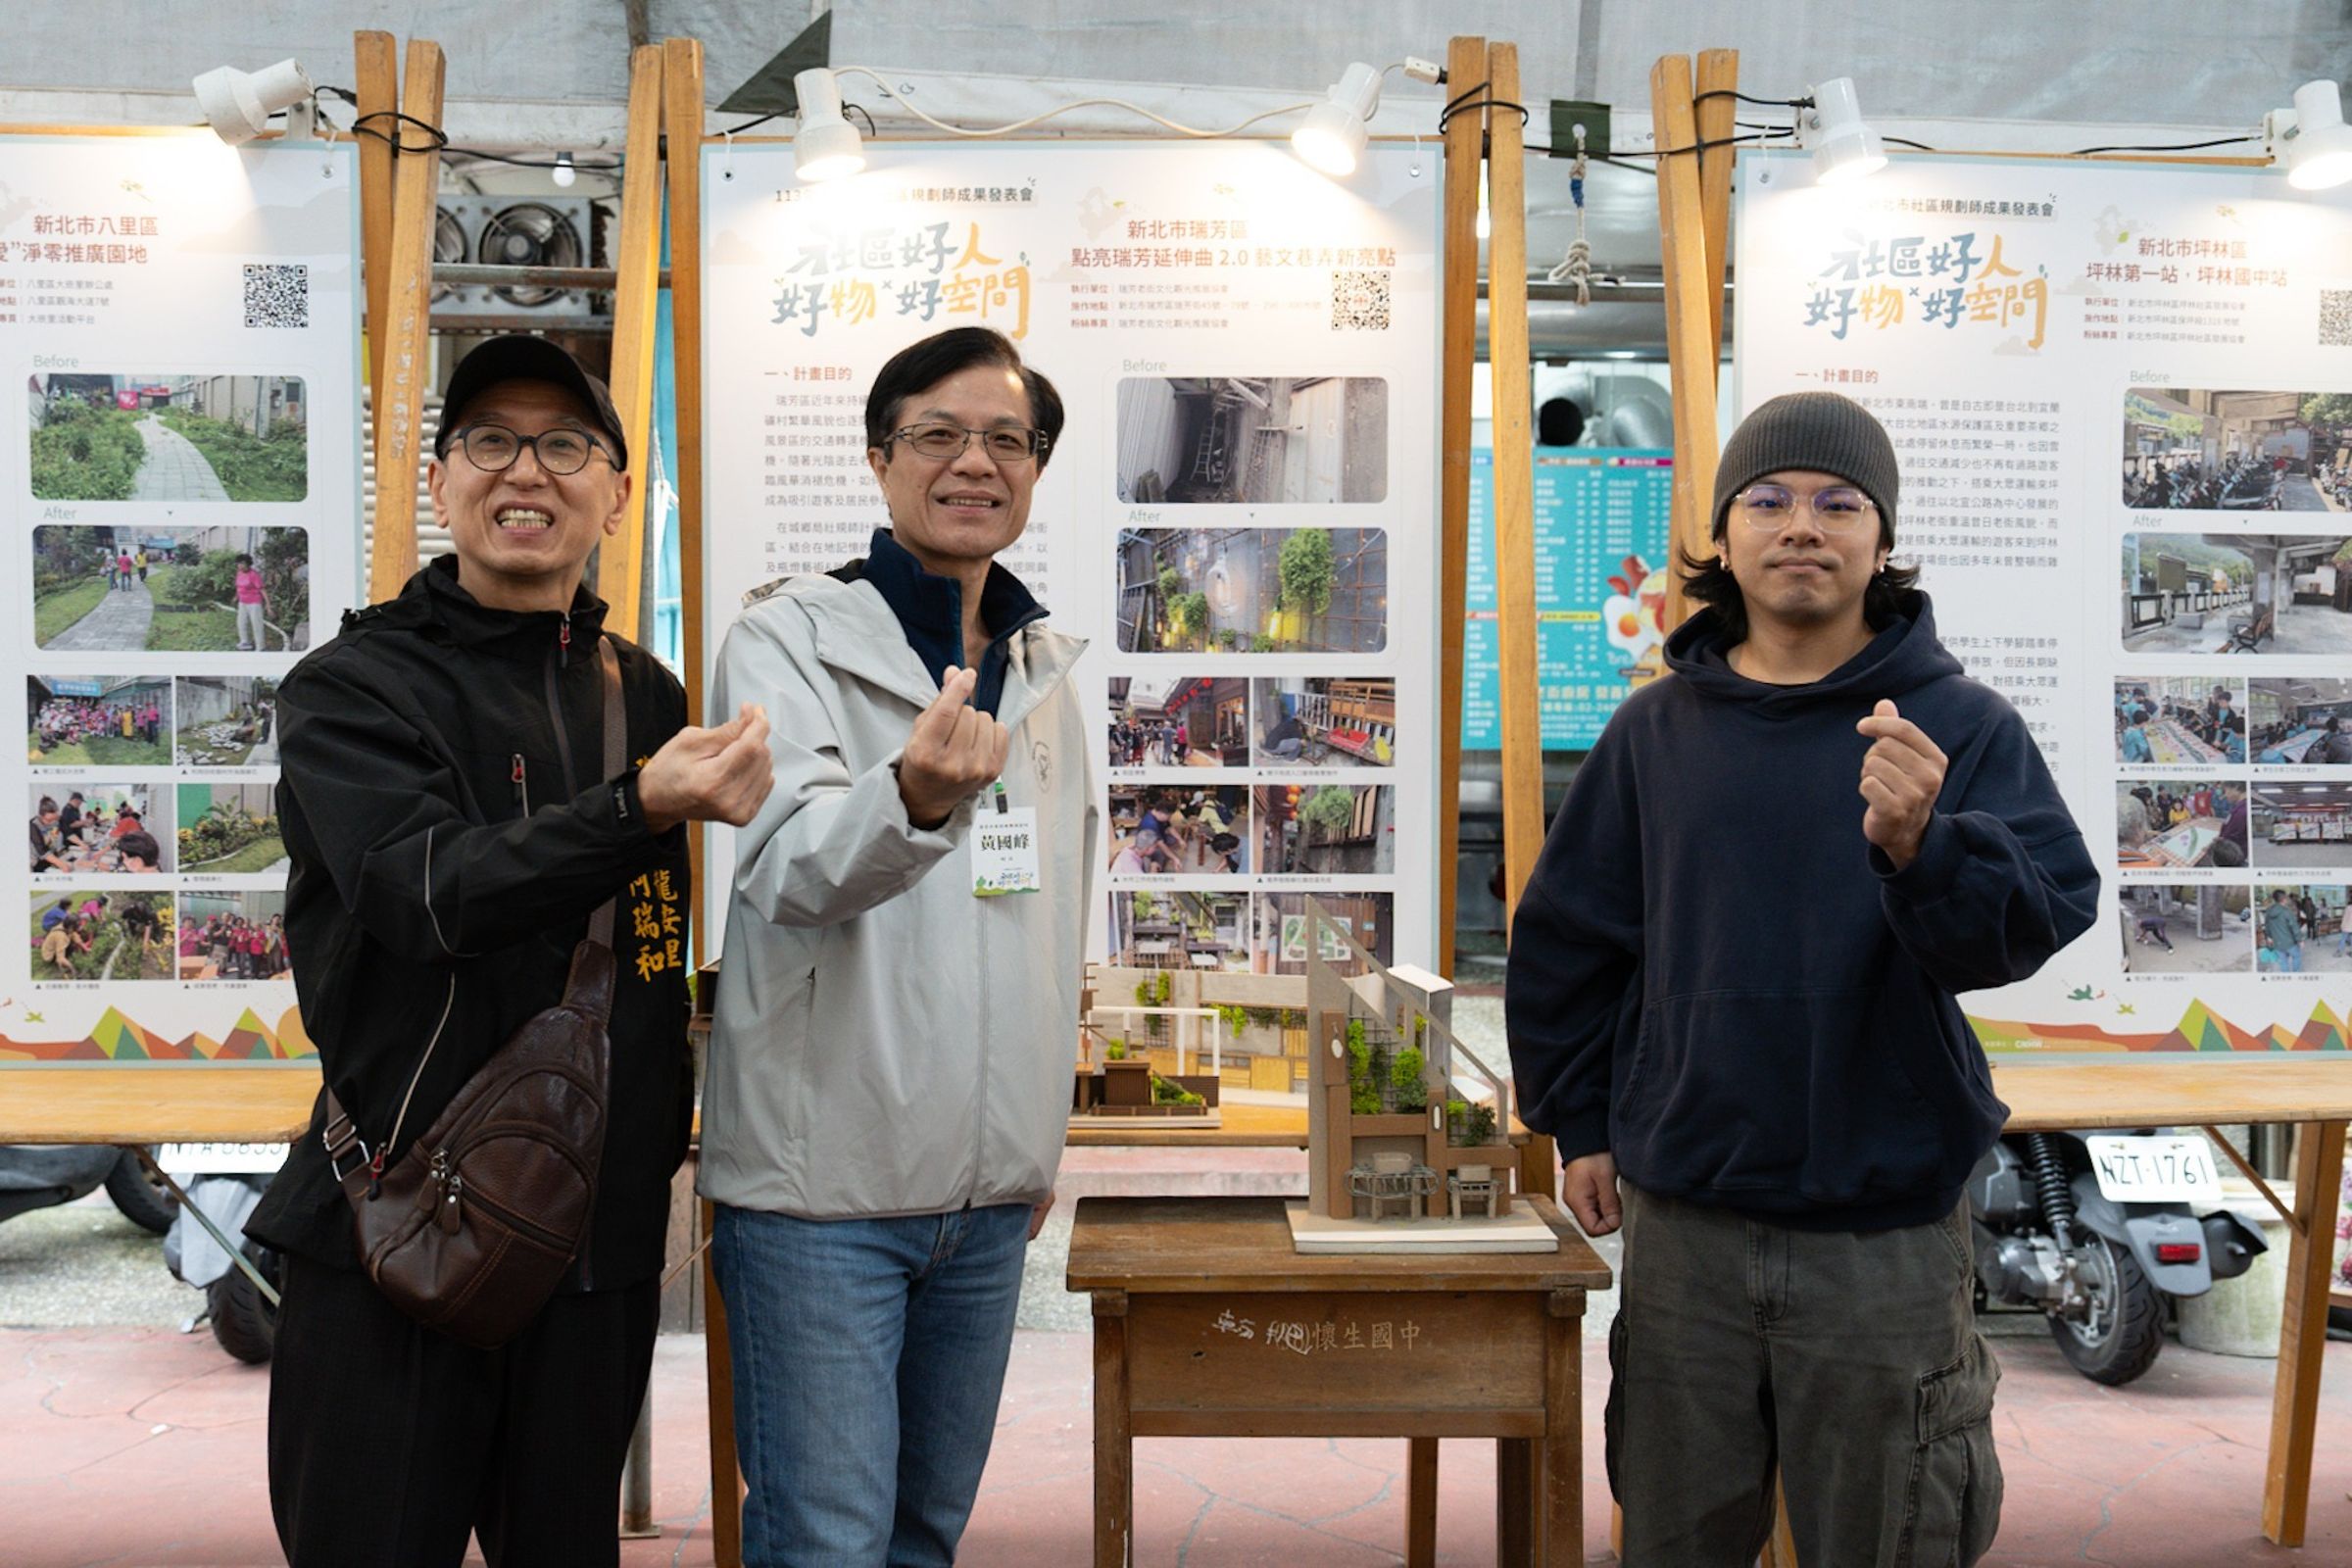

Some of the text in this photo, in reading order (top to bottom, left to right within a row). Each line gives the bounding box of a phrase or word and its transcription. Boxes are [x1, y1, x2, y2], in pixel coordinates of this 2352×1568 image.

[34, 215, 158, 236] 新北市八里區
[1127, 220, 1248, 239] 新北市瑞芳區
[2138, 238, 2247, 259] 新北市坪林區
[1072, 247, 1396, 268] 點亮瑞芳延伸曲 2.0 藝文巷弄新亮點
[33, 355, 78, 368] Before
[1122, 359, 1167, 372] Before
[2130, 369, 2171, 383] Before
[43, 506, 76, 519] After
[1129, 510, 1161, 522] After
[2132, 515, 2162, 527] After
